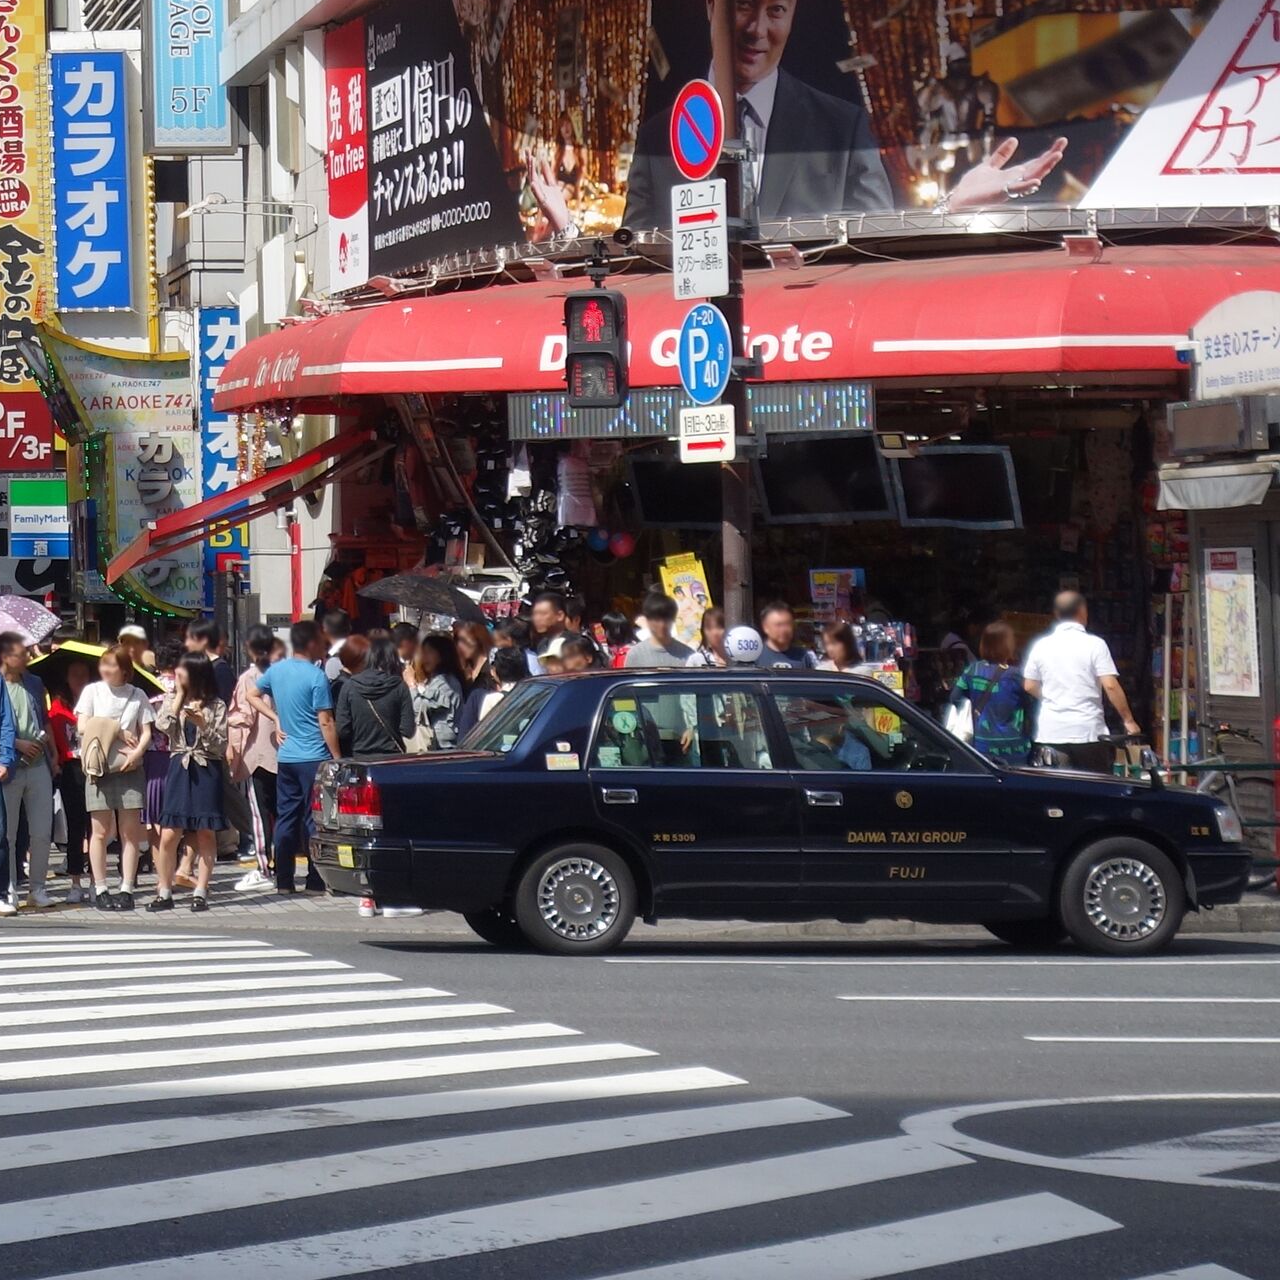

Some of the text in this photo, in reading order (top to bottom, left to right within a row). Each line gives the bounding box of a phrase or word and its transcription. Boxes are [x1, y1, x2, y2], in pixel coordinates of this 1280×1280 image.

[170, 86, 212, 114] 5F
[329, 74, 363, 142] 免税
[329, 146, 364, 180] Tax Free
[62, 61, 122, 299] カラオケ
[0, 192, 17, 202] no
[14, 514, 67, 525] FamilyMart
[672, 834, 696, 842] 5309
[847, 831, 967, 843] DAIWA TAXI GROUP
[889, 867, 926, 879] FUJI
